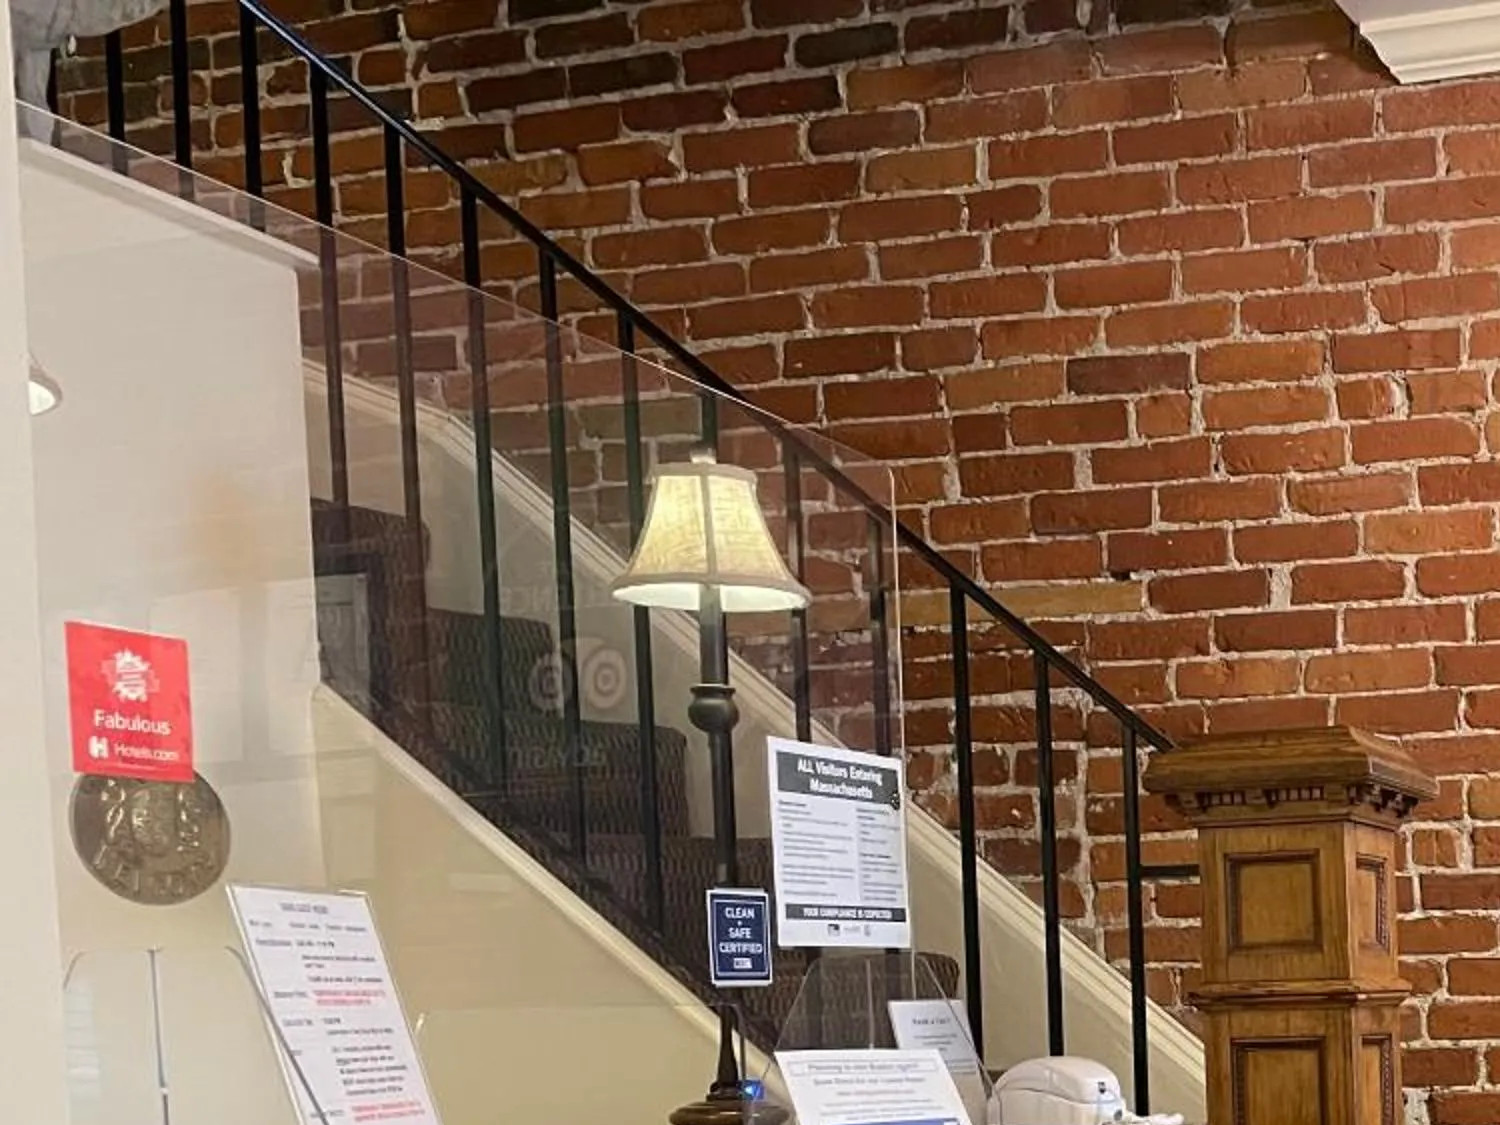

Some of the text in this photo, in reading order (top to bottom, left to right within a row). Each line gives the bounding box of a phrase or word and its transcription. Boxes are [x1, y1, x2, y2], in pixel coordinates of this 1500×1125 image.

[93, 708, 172, 736] Fabulous
[114, 742, 180, 762] Hotels.com
[797, 758, 883, 787] ALL Visitors Entering
[809, 778, 873, 799] Massachusetts
[725, 907, 755, 919] CLEAN
[728, 927, 752, 939] SAFE
[719, 942, 763, 954] CERTIFIED
